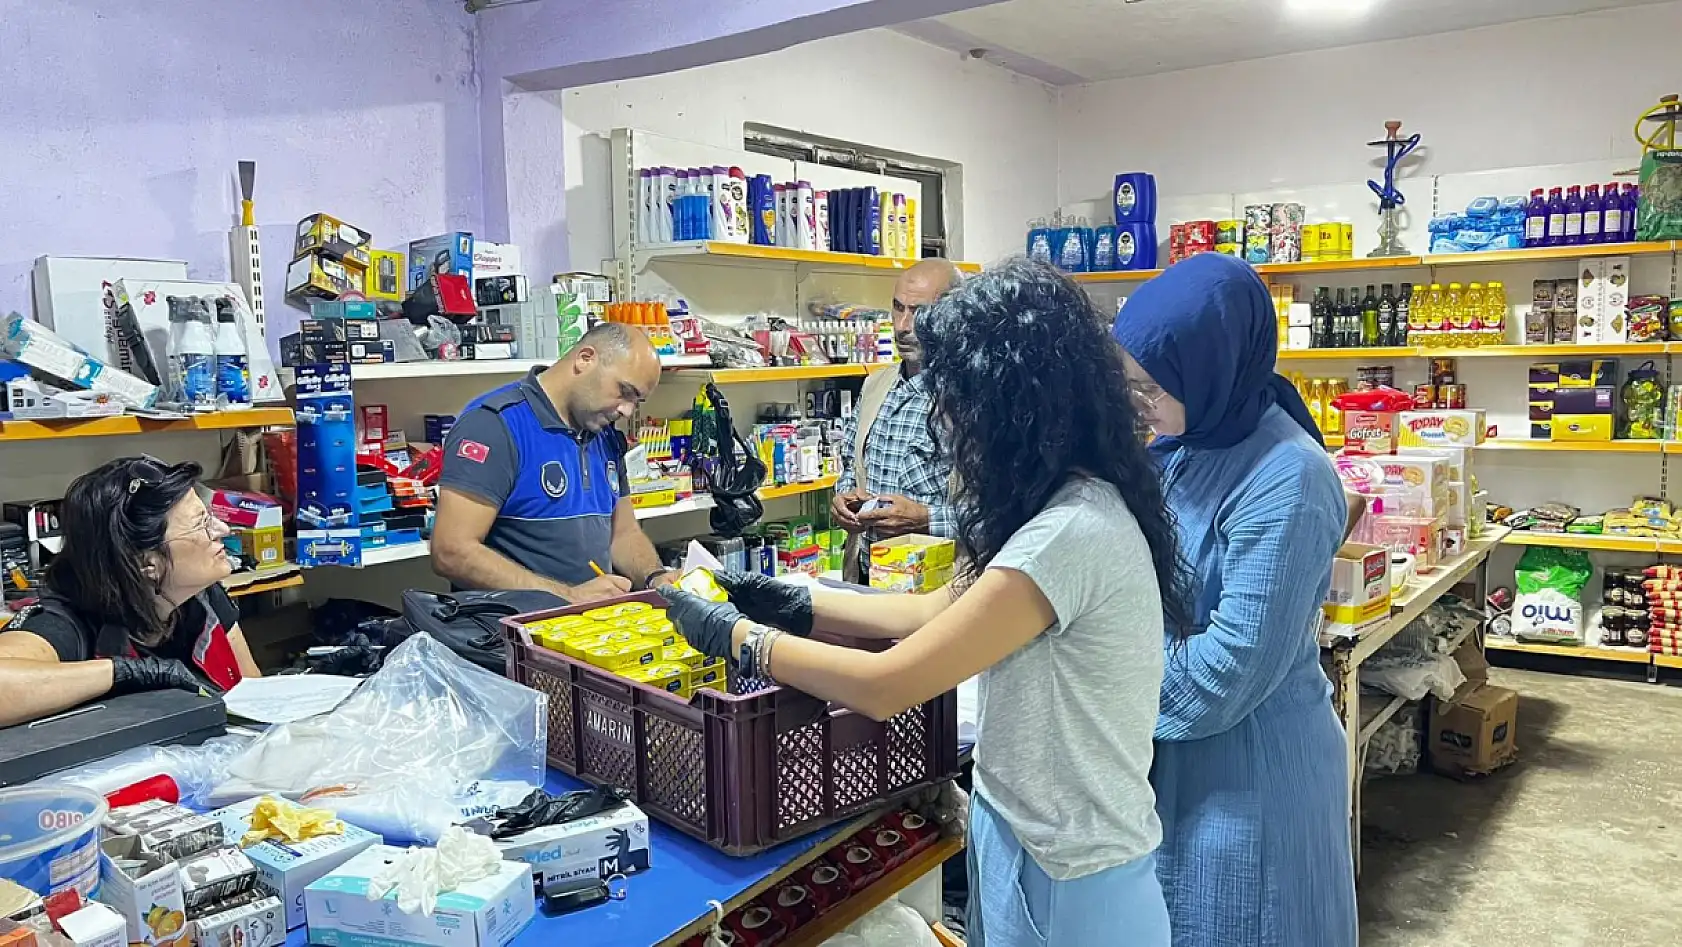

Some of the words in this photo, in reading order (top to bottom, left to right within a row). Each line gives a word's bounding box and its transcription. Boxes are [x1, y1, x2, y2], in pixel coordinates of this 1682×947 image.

[1408, 416, 1444, 433] TODAY
[1522, 605, 1571, 625] mio
[604, 858, 619, 875] M
[325, 899, 337, 914] L
